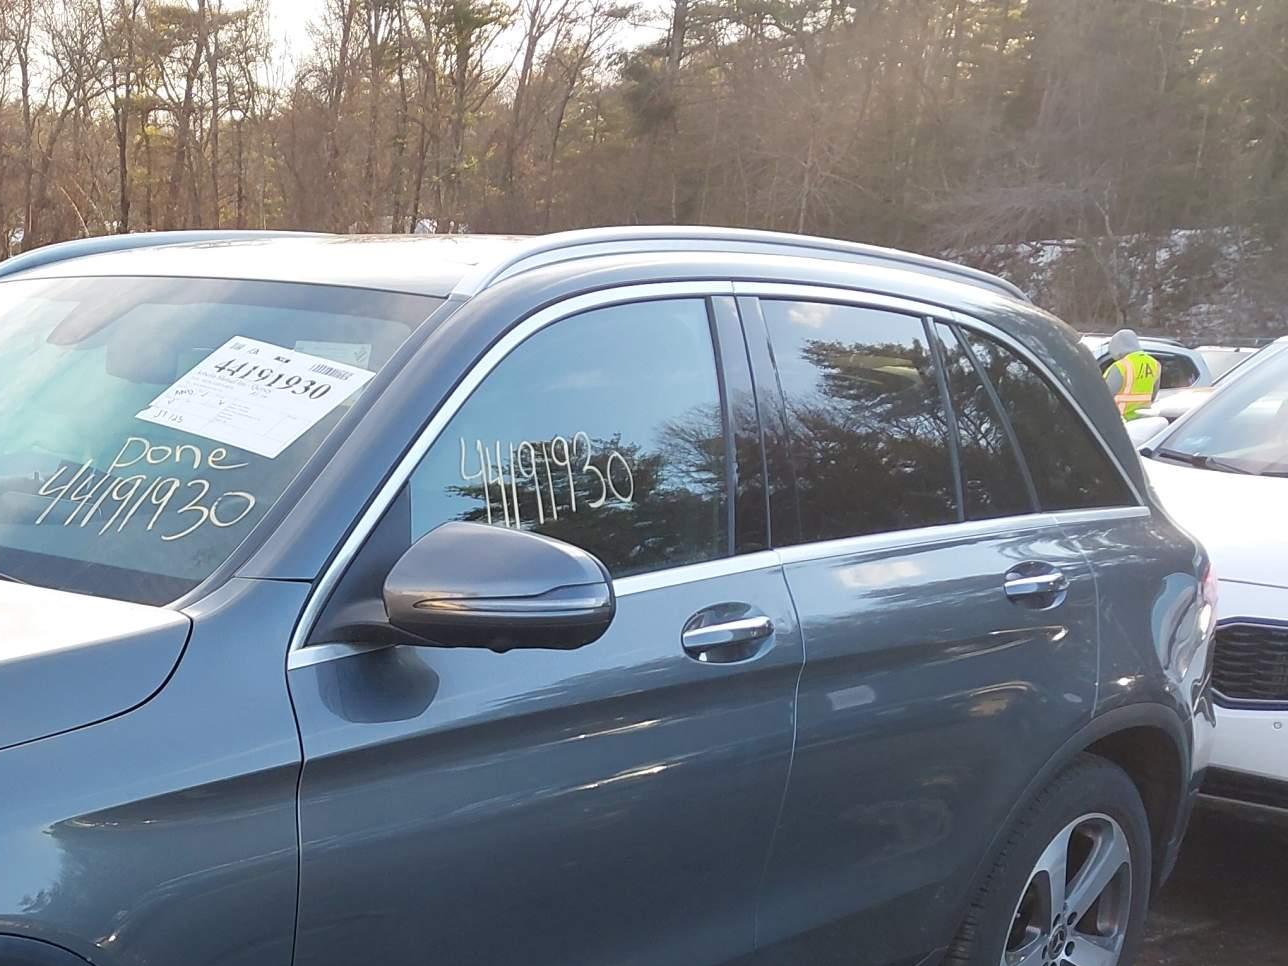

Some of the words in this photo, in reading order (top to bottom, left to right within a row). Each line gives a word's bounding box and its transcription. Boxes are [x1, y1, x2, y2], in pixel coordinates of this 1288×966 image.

[214, 358, 332, 400] 44191930
[107, 436, 249, 475] Done
[459, 431, 634, 530] 44191930
[35, 458, 256, 541] 44191930
